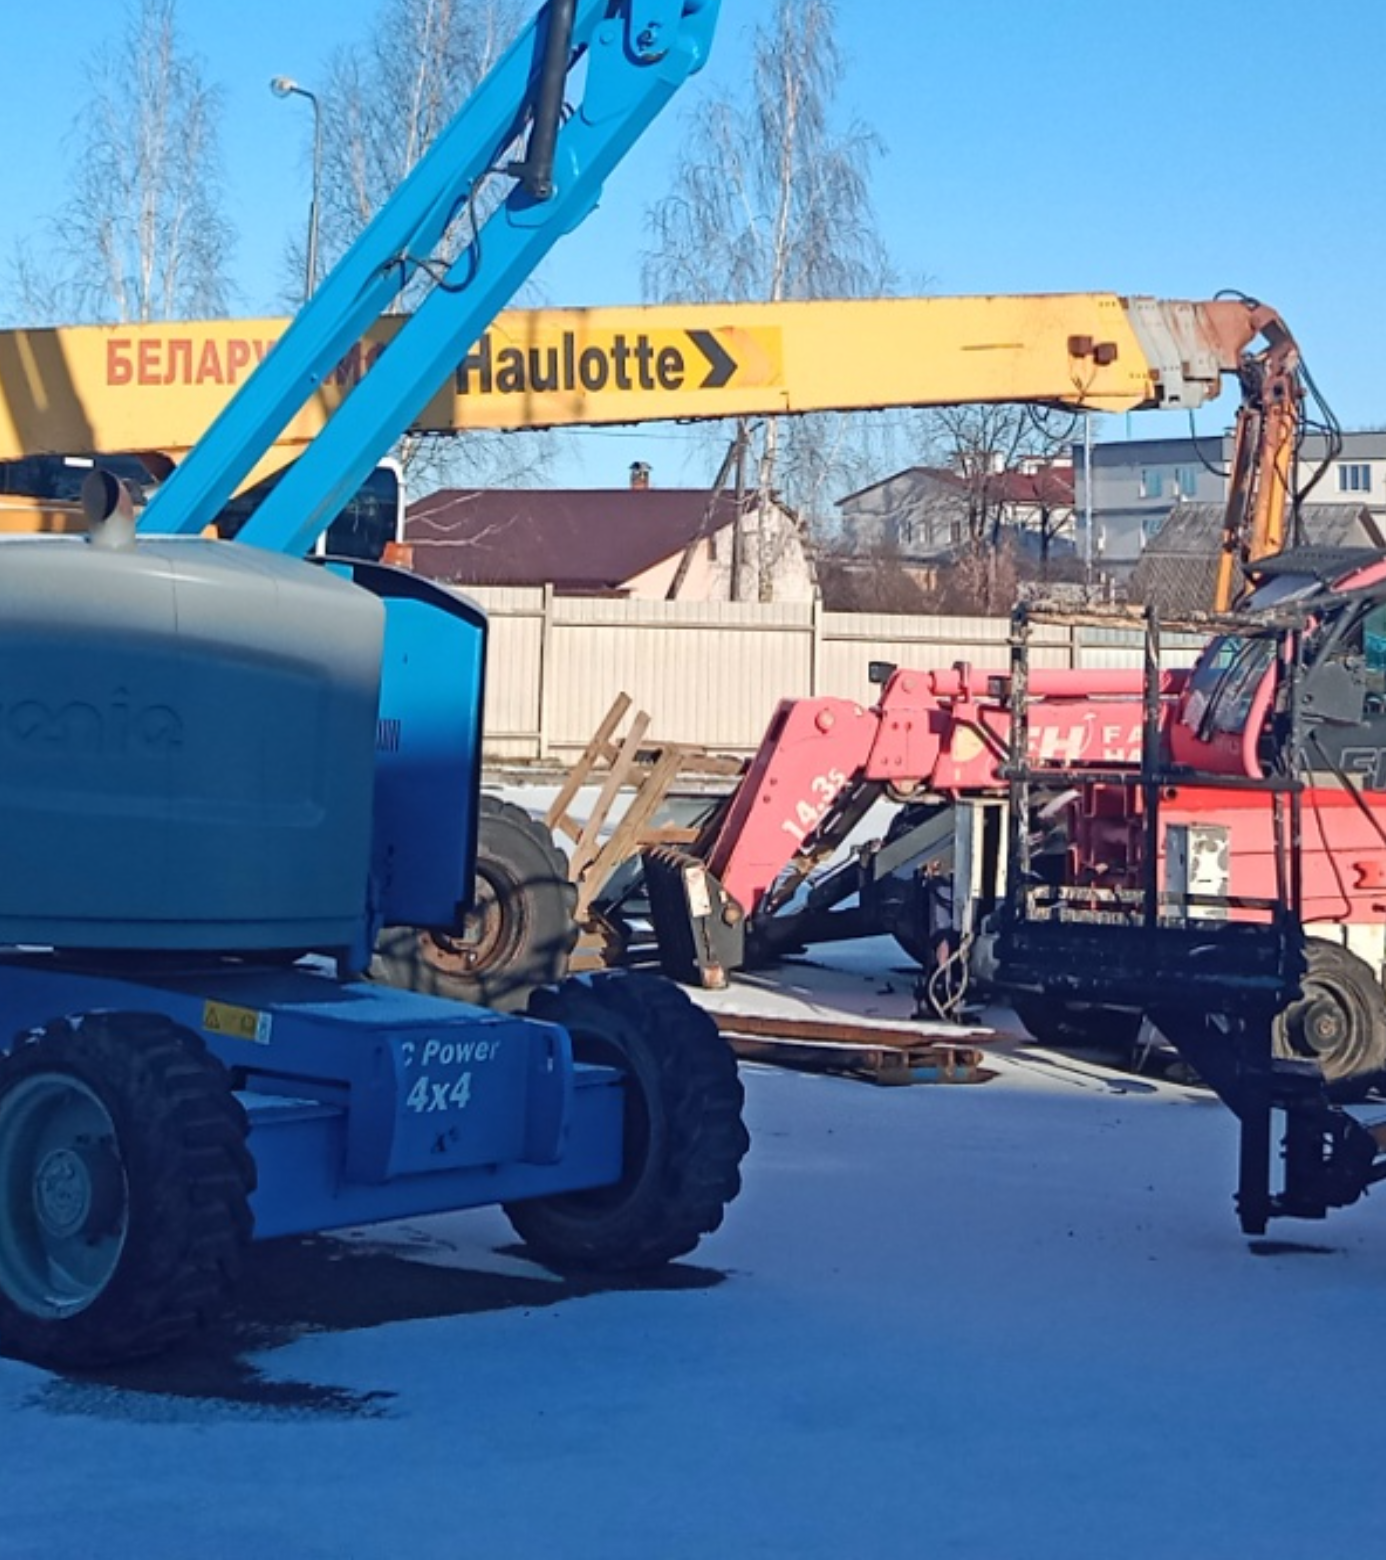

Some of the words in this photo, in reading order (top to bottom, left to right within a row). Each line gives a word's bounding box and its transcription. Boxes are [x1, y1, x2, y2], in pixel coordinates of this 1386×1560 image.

[455, 331, 684, 395] Haulotte
[780, 767, 847, 842] 14.3s
[421, 1039, 502, 1067] Power
[406, 1071, 472, 1114] 4x4
